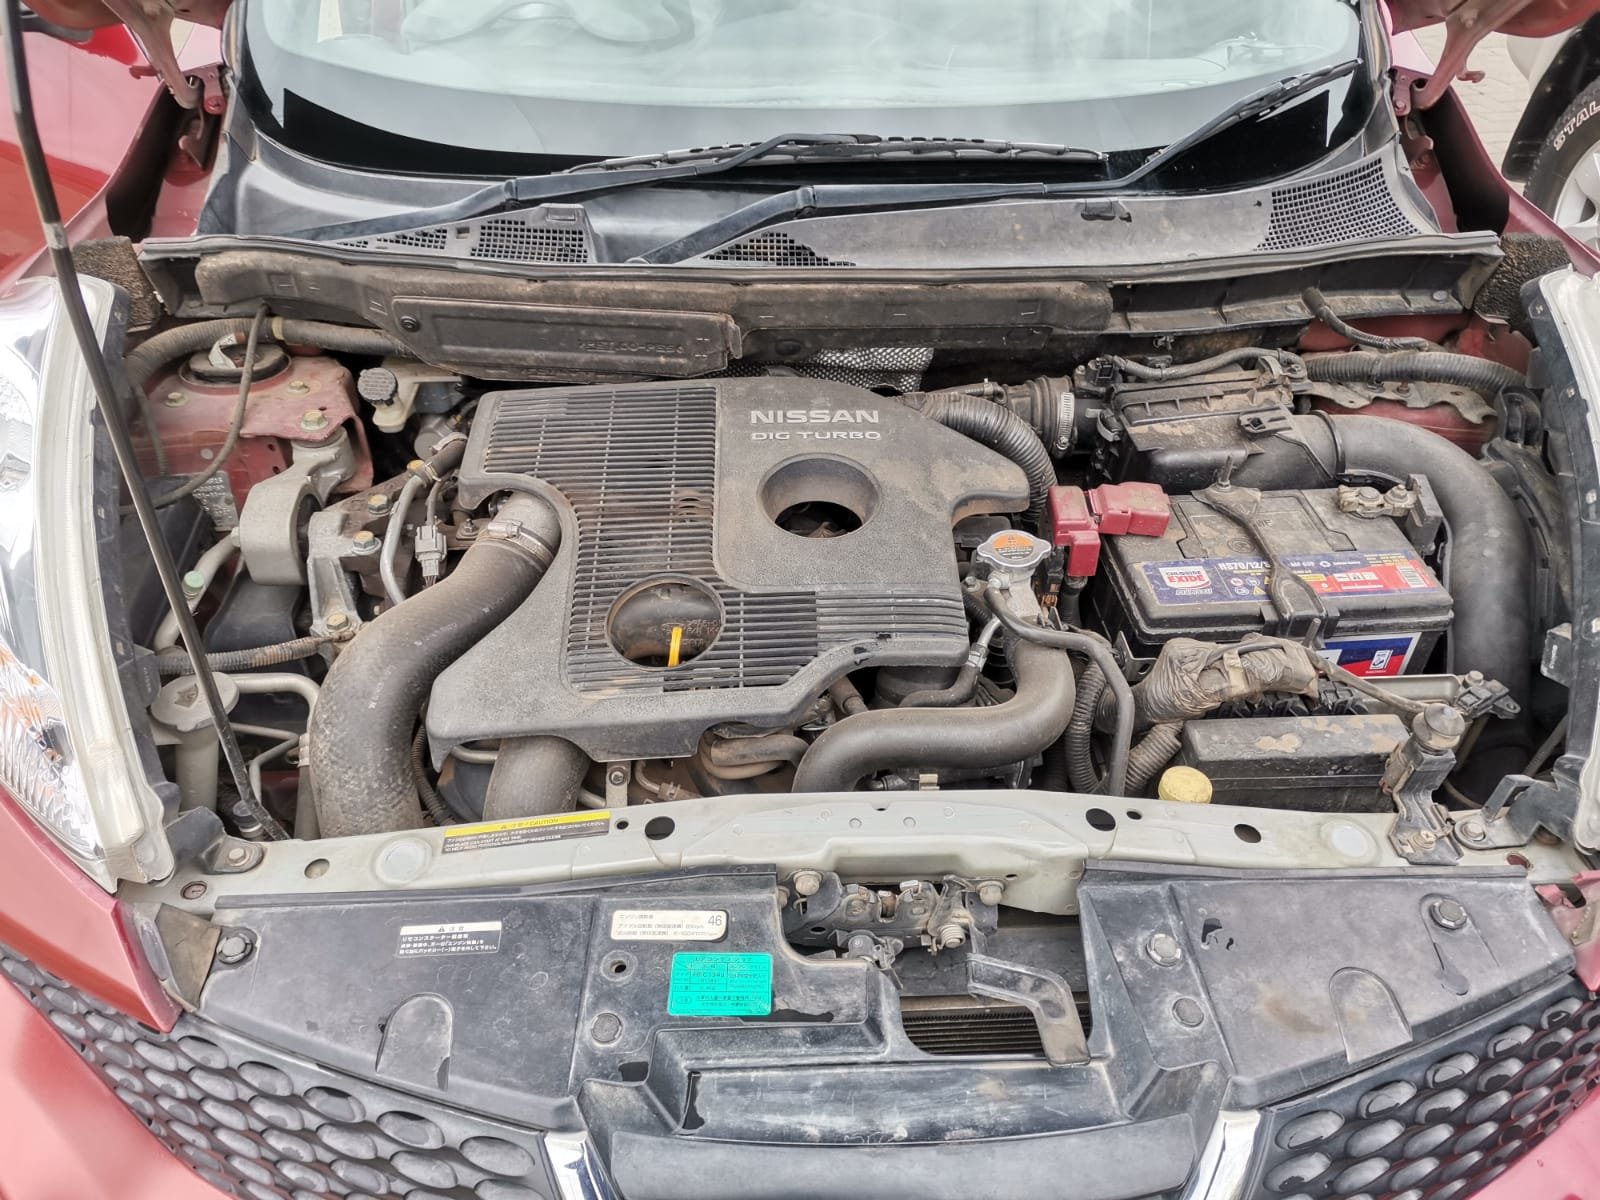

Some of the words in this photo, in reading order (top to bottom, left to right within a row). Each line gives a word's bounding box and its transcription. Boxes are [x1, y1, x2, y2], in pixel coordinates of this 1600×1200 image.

[750, 409, 879, 424] NISSAN
[751, 432, 791, 440] DIG
[797, 431, 881, 440] TURBO
[1167, 575, 1205, 583] EXIDE
[708, 915, 722, 926] 46
